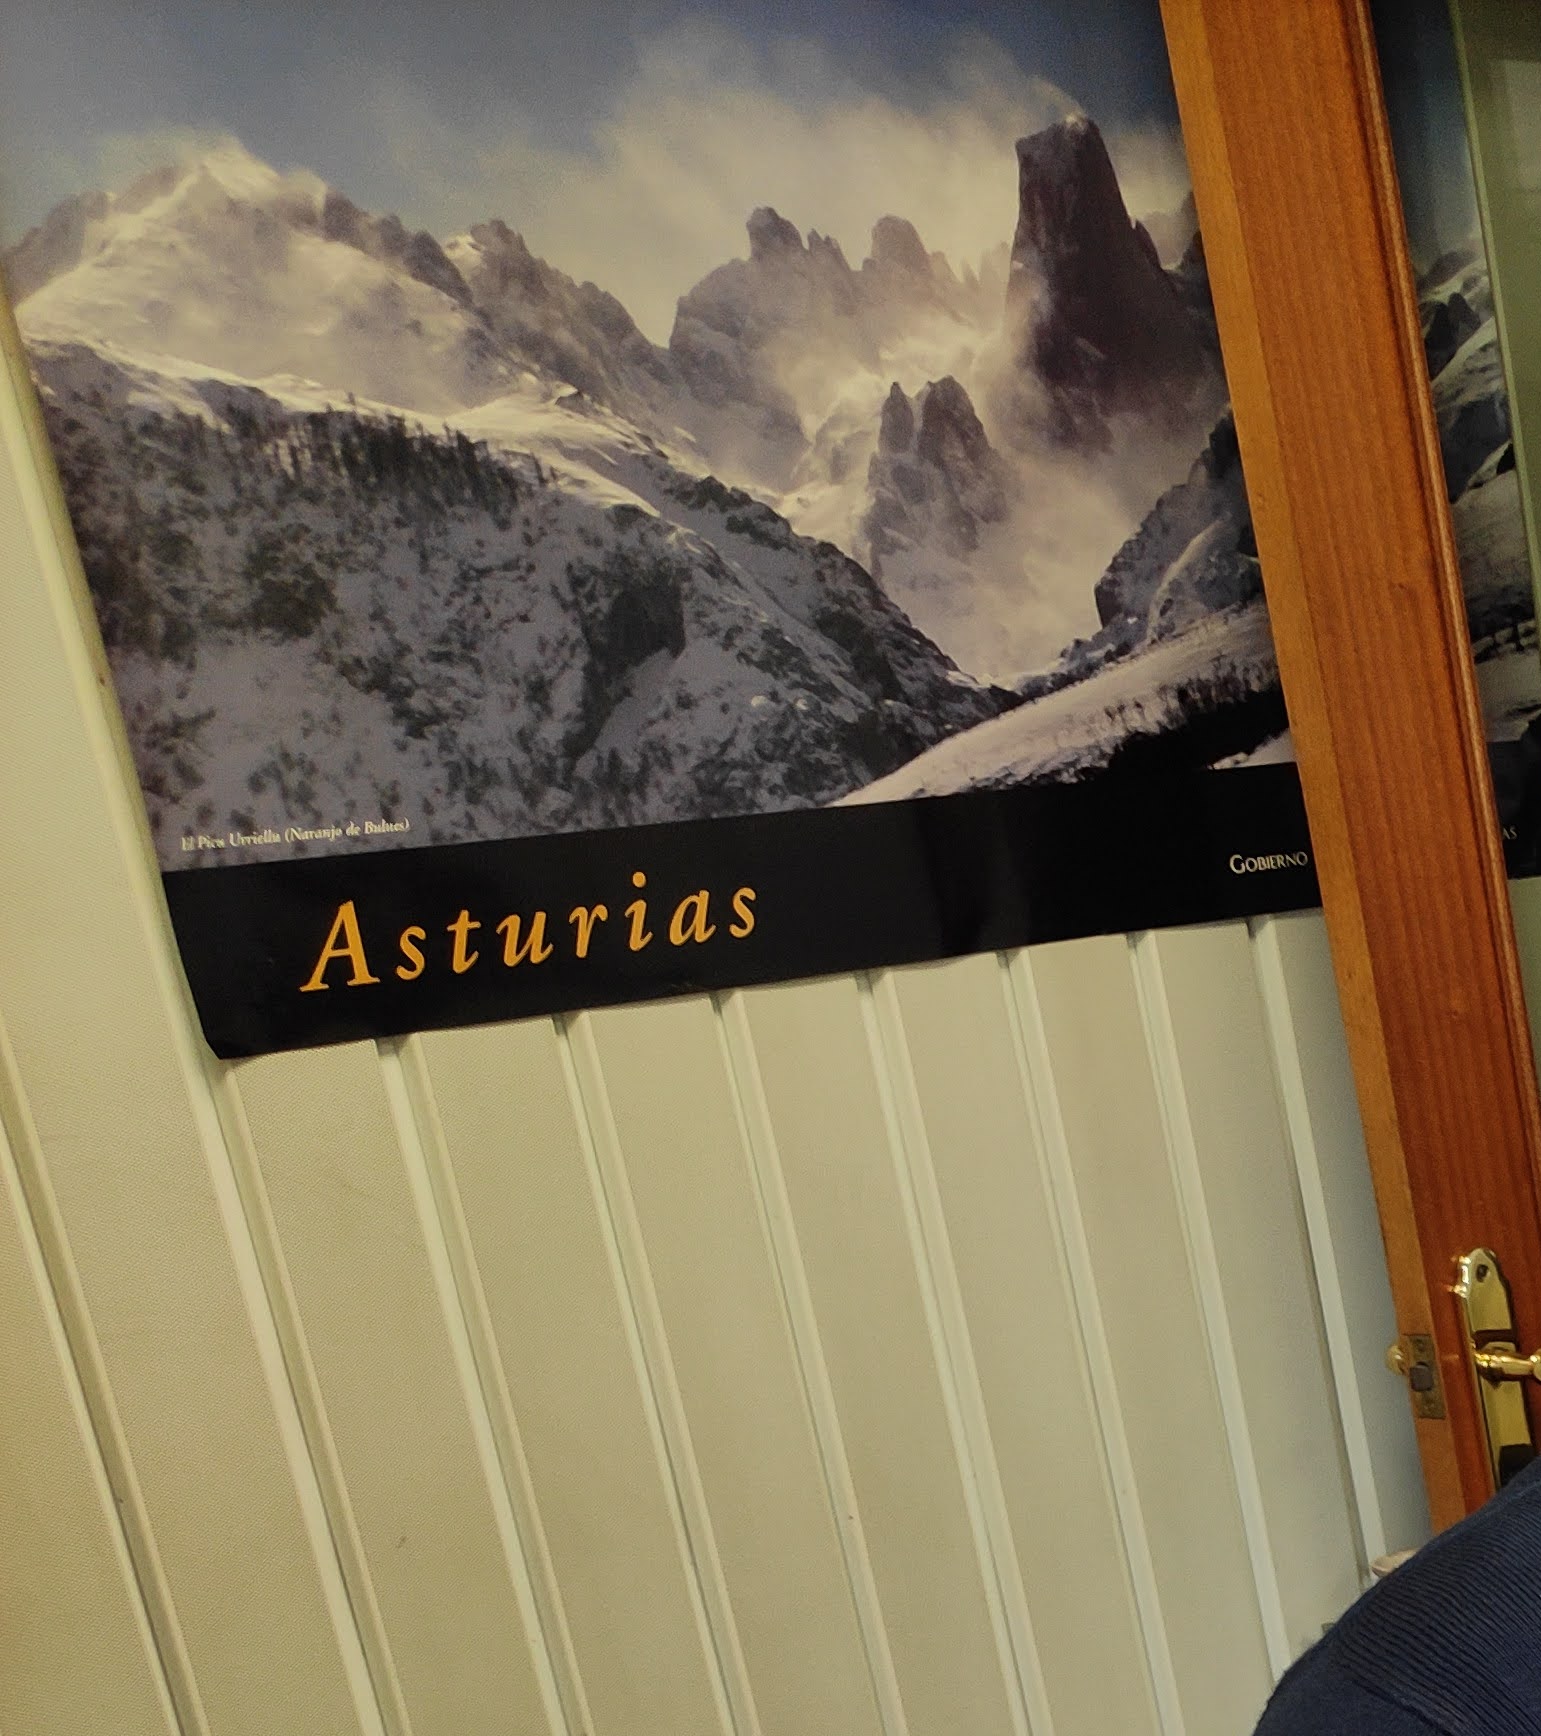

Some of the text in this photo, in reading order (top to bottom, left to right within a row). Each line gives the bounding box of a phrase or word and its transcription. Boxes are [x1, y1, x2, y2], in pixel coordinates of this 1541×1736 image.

[346, 821, 361, 836] de
[1229, 851, 1308, 874] GOBIERNO
[299, 871, 757, 993] Asturias
